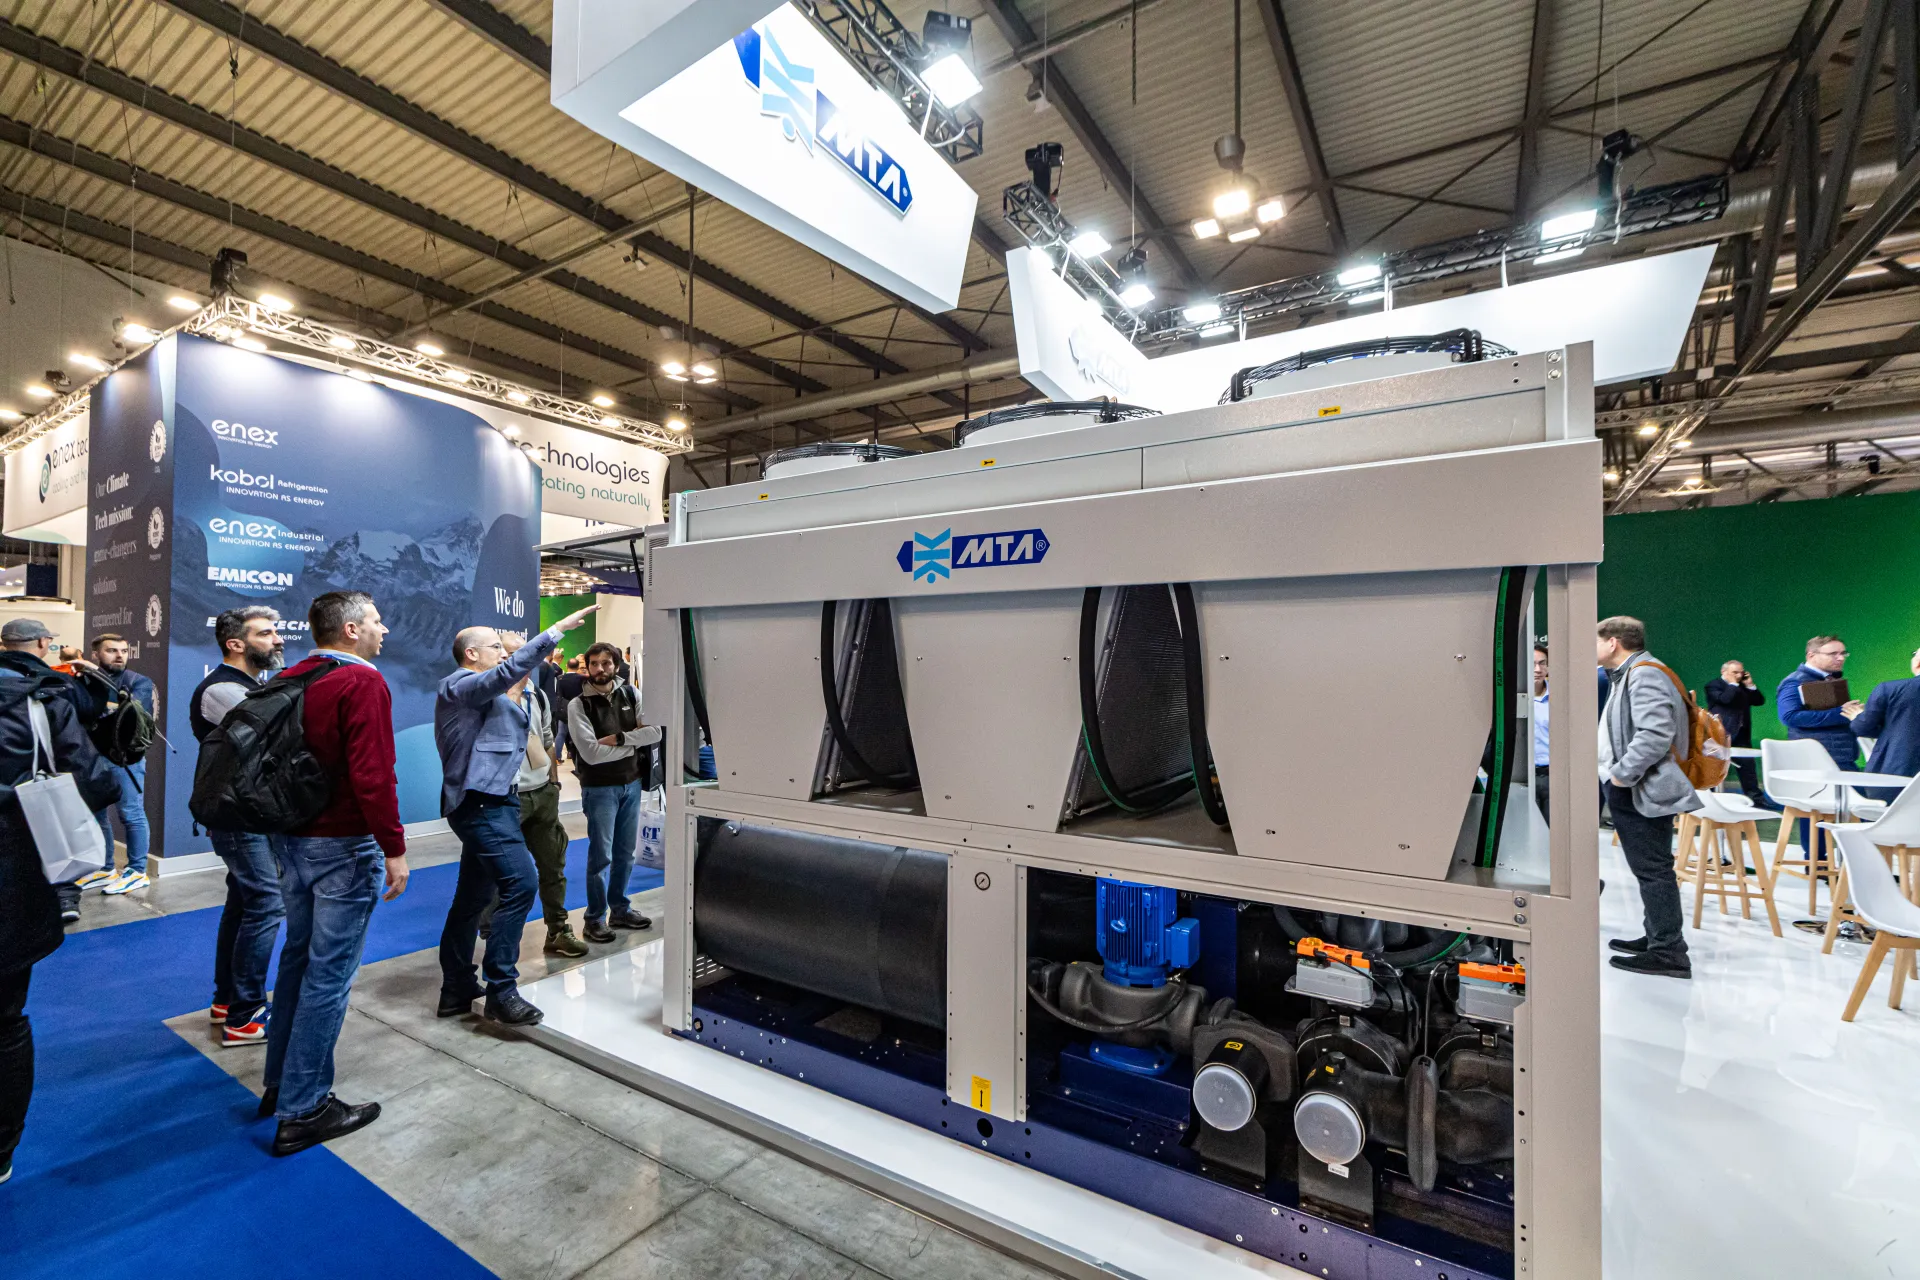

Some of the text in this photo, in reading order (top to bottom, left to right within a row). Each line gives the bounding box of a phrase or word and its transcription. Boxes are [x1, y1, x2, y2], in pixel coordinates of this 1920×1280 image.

[211, 419, 279, 446] enex
[52, 440, 76, 469] enex
[507, 436, 650, 484] hnologies
[106, 472, 129, 494] Climate
[277, 480, 328, 494] Refrigeration
[225, 486, 325, 506] INNOVATION AS ENERGY
[591, 487, 651, 512] naturally
[95, 510, 108, 531] Tech
[209, 518, 324, 542] enex Industrial
[218, 536, 316, 553] INNOVATION AS ENERGY
[207, 566, 294, 587] EMICON
[215, 582, 253, 590] INNOVATION
[494, 586, 525, 619] We do
